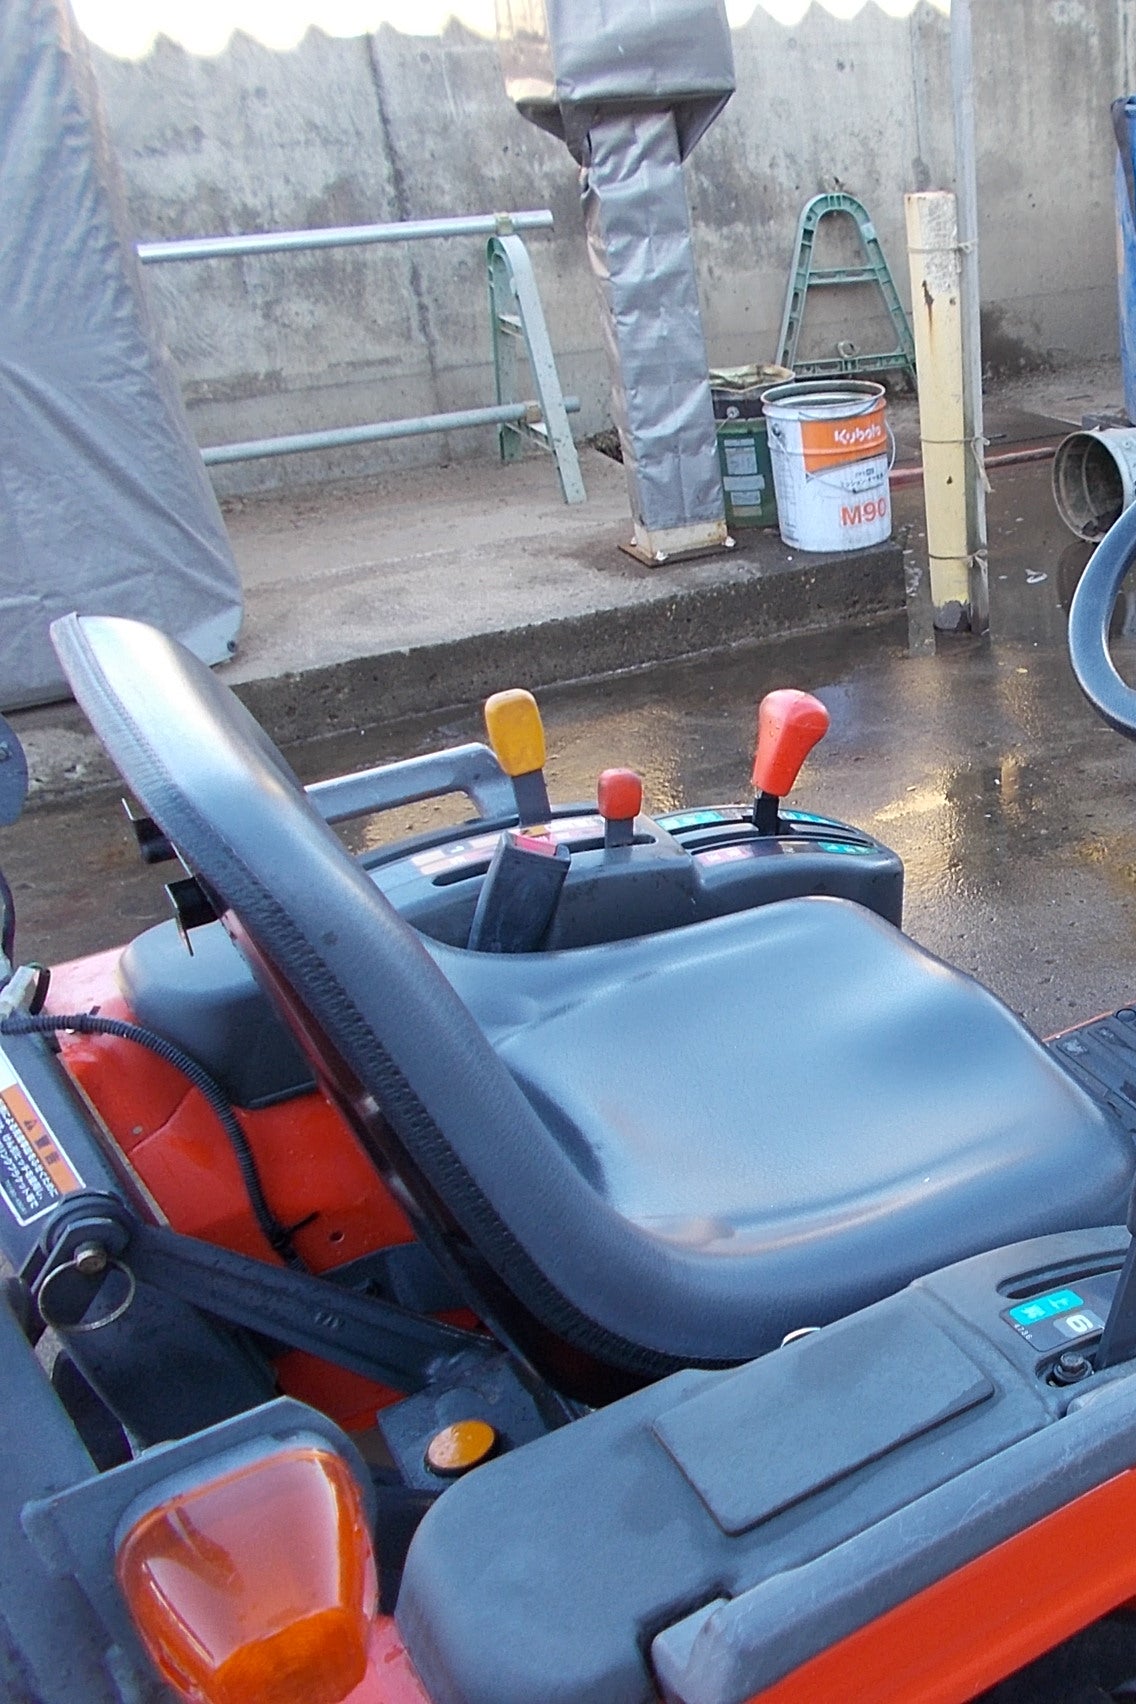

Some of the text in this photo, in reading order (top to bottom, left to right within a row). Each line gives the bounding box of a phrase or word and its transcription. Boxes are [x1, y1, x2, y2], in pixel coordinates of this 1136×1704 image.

[834, 425, 881, 444] Kubota
[841, 498, 886, 526] M90
[1066, 1314, 1094, 1333] 6
